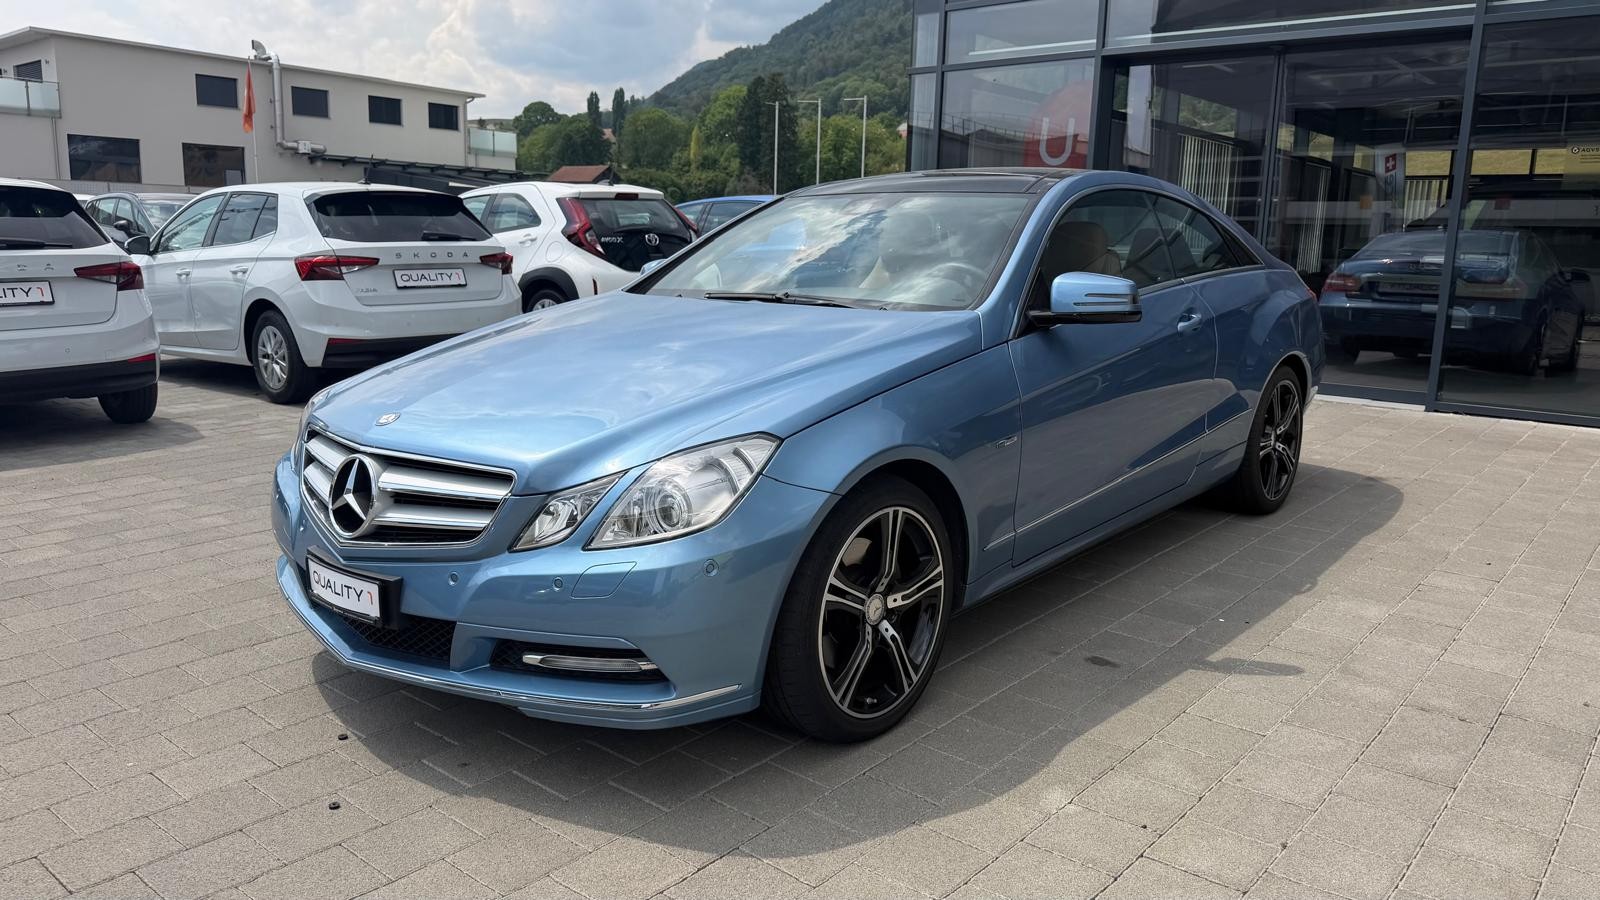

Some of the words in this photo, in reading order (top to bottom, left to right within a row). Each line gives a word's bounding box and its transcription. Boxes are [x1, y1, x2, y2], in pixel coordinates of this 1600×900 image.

[1039, 117, 1076, 166] U
[400, 272, 453, 282] QUALITY
[312, 570, 363, 602] QUALITY
[367, 591, 373, 605] 1
